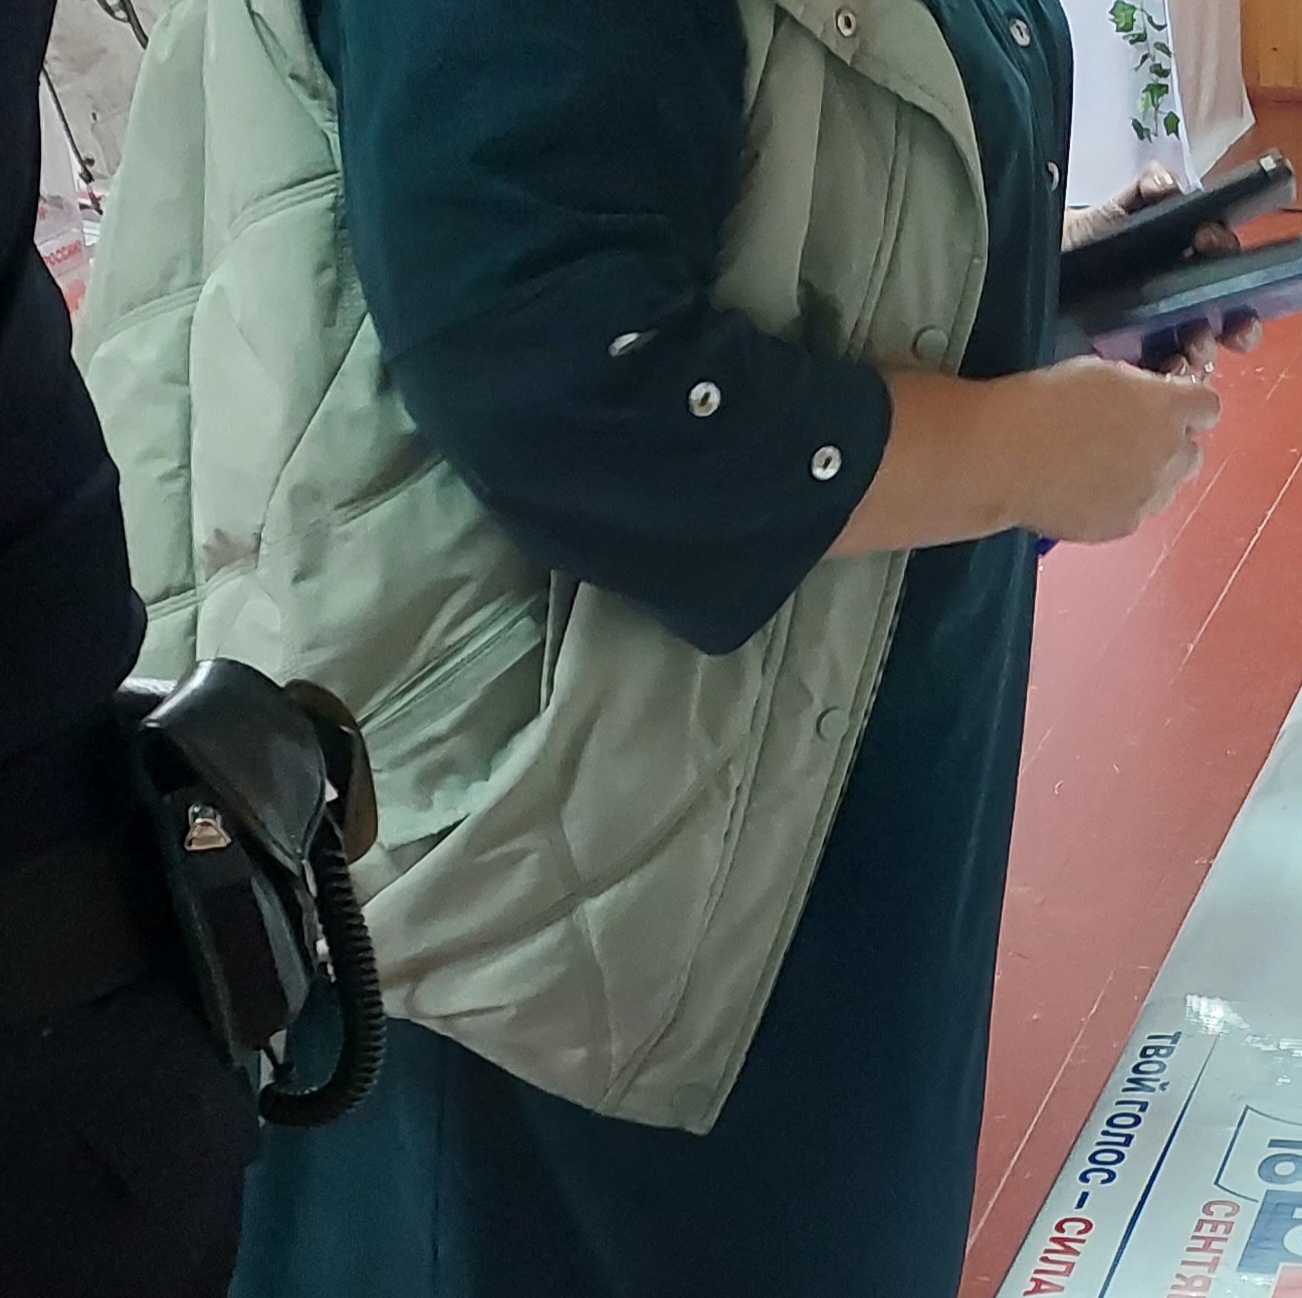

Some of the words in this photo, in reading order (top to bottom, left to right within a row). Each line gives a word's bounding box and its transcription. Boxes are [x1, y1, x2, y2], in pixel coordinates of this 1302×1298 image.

[1121, 1030, 1183, 1094] ТВОЙ
[1077, 1098, 1149, 1186] ГОЛОС
[1022, 1216, 1094, 1298] СИЛА
